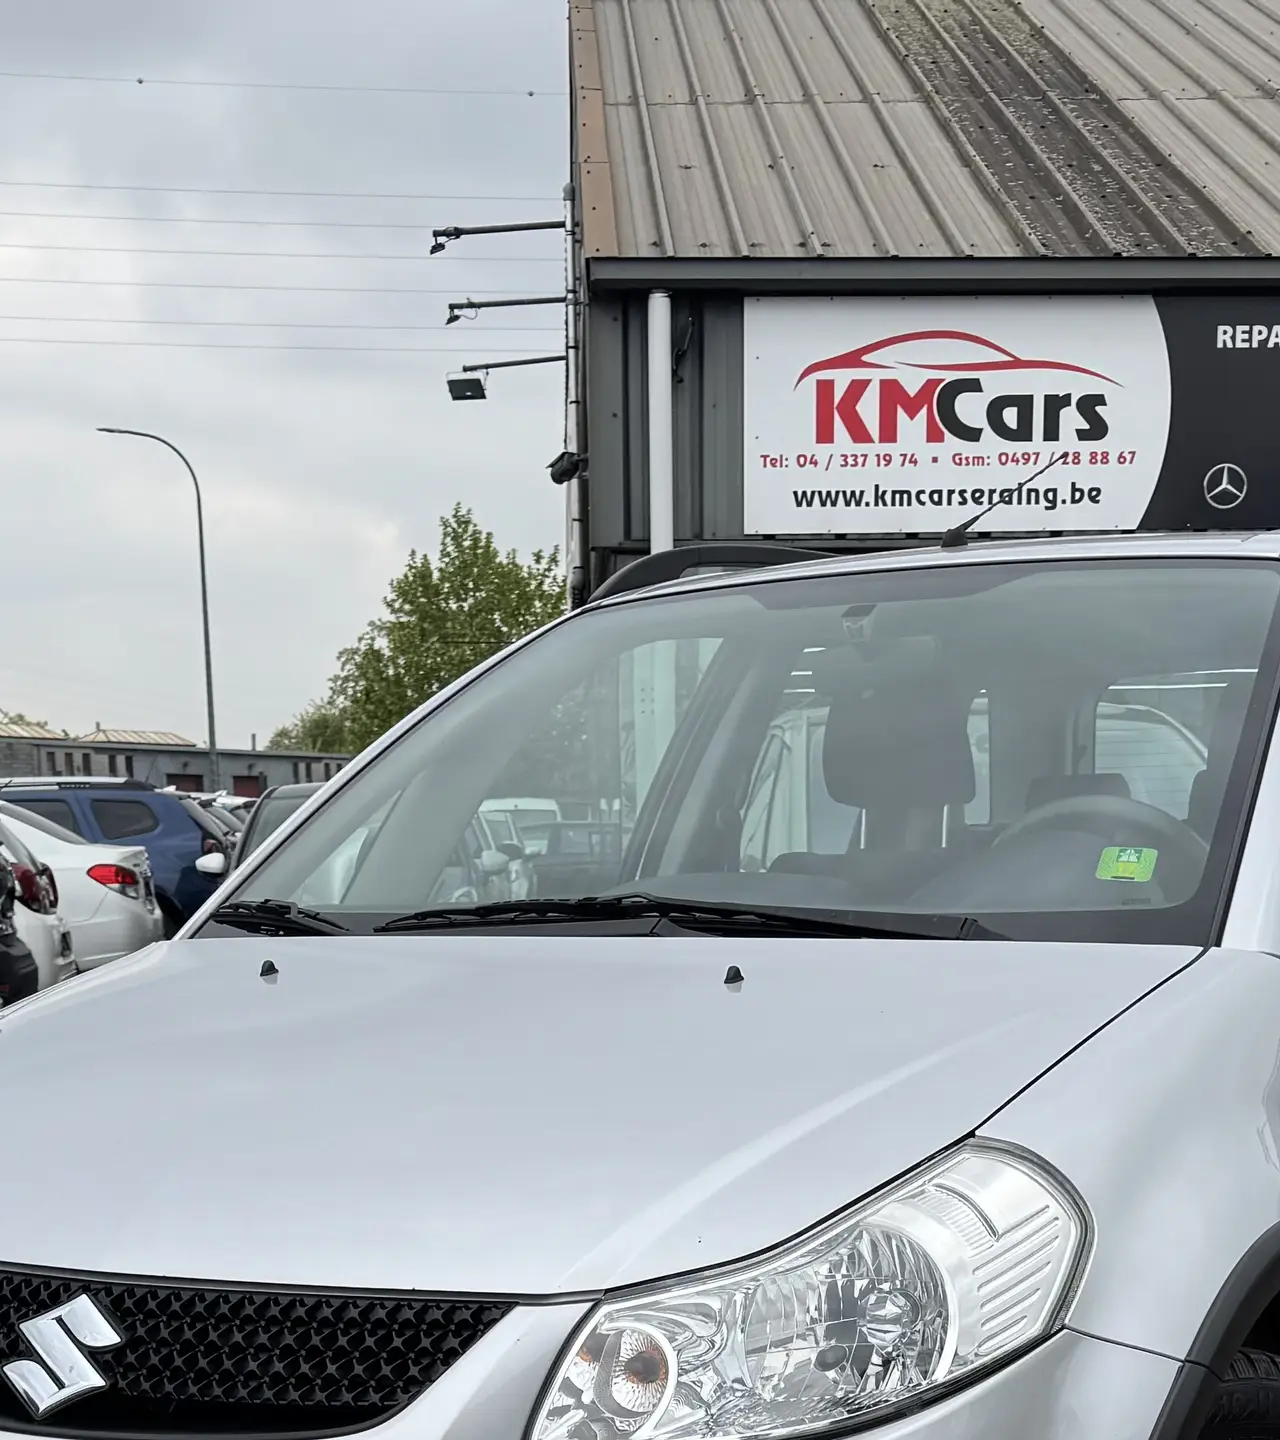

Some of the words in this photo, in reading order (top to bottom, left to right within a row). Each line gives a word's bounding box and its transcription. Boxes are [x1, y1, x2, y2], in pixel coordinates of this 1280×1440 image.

[815, 377, 1109, 444] KMCars
[759, 454, 789, 469] Tel:
[796, 453, 819, 469] 04
[824, 453, 834, 472] /
[839, 453, 869, 468] 337
[874, 453, 893, 468] 19
[899, 452, 919, 468] 74
[951, 452, 991, 467] Gsm:
[997, 451, 1041, 466] 0497
[1061, 451, 1082, 466] 28
[1088, 451, 1110, 466] 88
[1117, 450, 1137, 465] 67
[792, 481, 1102, 512] www.kmcarseraing.be
